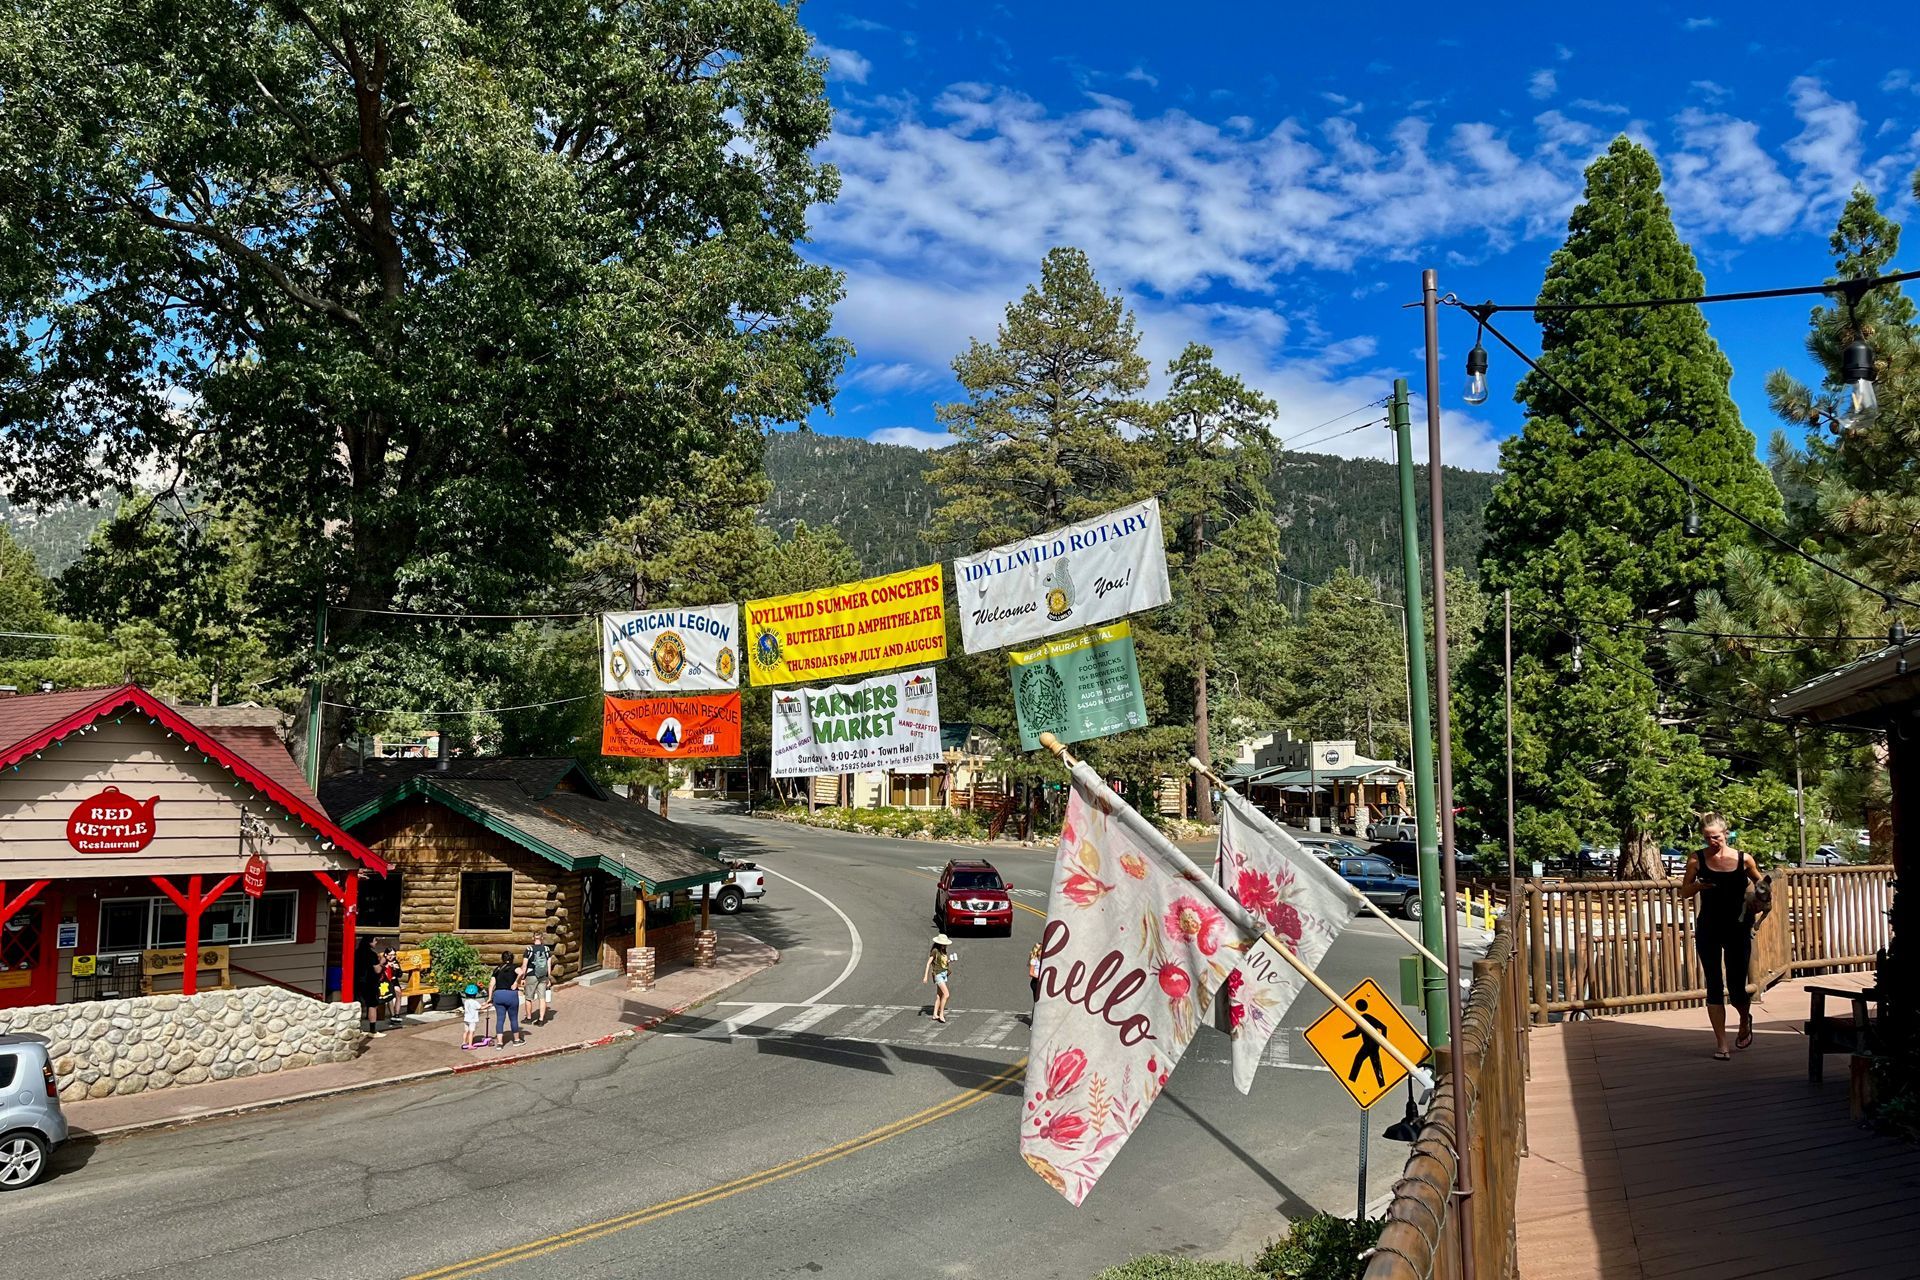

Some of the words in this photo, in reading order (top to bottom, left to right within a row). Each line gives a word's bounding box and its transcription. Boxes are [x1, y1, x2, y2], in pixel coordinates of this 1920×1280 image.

[966, 540, 1066, 582] IDYLLWILD
[1070, 511, 1149, 552] ROTARY
[751, 602, 814, 625] IDYLLWILD
[816, 591, 868, 615] SUMMER
[870, 575, 940, 605] CONCERTS
[972, 601, 1038, 626] Welcomes
[1094, 568, 1131, 599] You!
[612, 612, 675, 645] AMERICAN
[680, 612, 730, 642] LEGION
[786, 622, 855, 646] BUTTERFIELD
[857, 605, 942, 634] AMPHITHEATER
[1052, 642, 1078, 654] MURAL
[1080, 631, 1114, 646] FESTIVAL
[786, 655, 838, 672] THURSDAYS
[839, 650, 857, 666] 6PM
[858, 646, 882, 664] JULY
[883, 642, 903, 660] AND
[904, 635, 944, 655] AUGUST
[1086, 654, 1098, 662] LIVE
[1078, 664, 1098, 672] FOOD
[1098, 657, 1122, 668] TRUCKS
[634, 669, 650, 677] POST
[1020, 668, 1034, 694] PINTS
[1046, 664, 1064, 689] PINES
[1090, 666, 1126, 680] BREWERIES
[1078, 682, 1096, 690] FREE
[1104, 674, 1129, 685] ATTEND
[904, 684, 933, 698] IDYLLWILD
[1081, 692, 1096, 700] AUG
[1116, 683, 1130, 692] 6PM
[1104, 694, 1125, 704] CIRCLE
[806, 684, 898, 719] FARMERS
[606, 704, 650, 726] RIVERSIDE
[652, 702, 698, 717] MOUNTAIN
[701, 704, 738, 724] RESCUE
[685, 728, 704, 736] TOWN
[706, 726, 722, 734] HALL
[812, 711, 896, 744] MARKET
[898, 720, 938, 732] HAND-CRAFTED
[775, 743, 798, 756] ORGANIC
[798, 754, 822, 764] Sunday
[878, 746, 898, 756] Town
[900, 742, 914, 754] Hall
[91, 808, 132, 820] RED
[74, 822, 148, 837] KETTLE
[79, 840, 140, 849] Restaurant
[250, 866, 260, 876] RED
[245, 874, 263, 887] KETTLE
[1037, 920, 1158, 1047] hello
